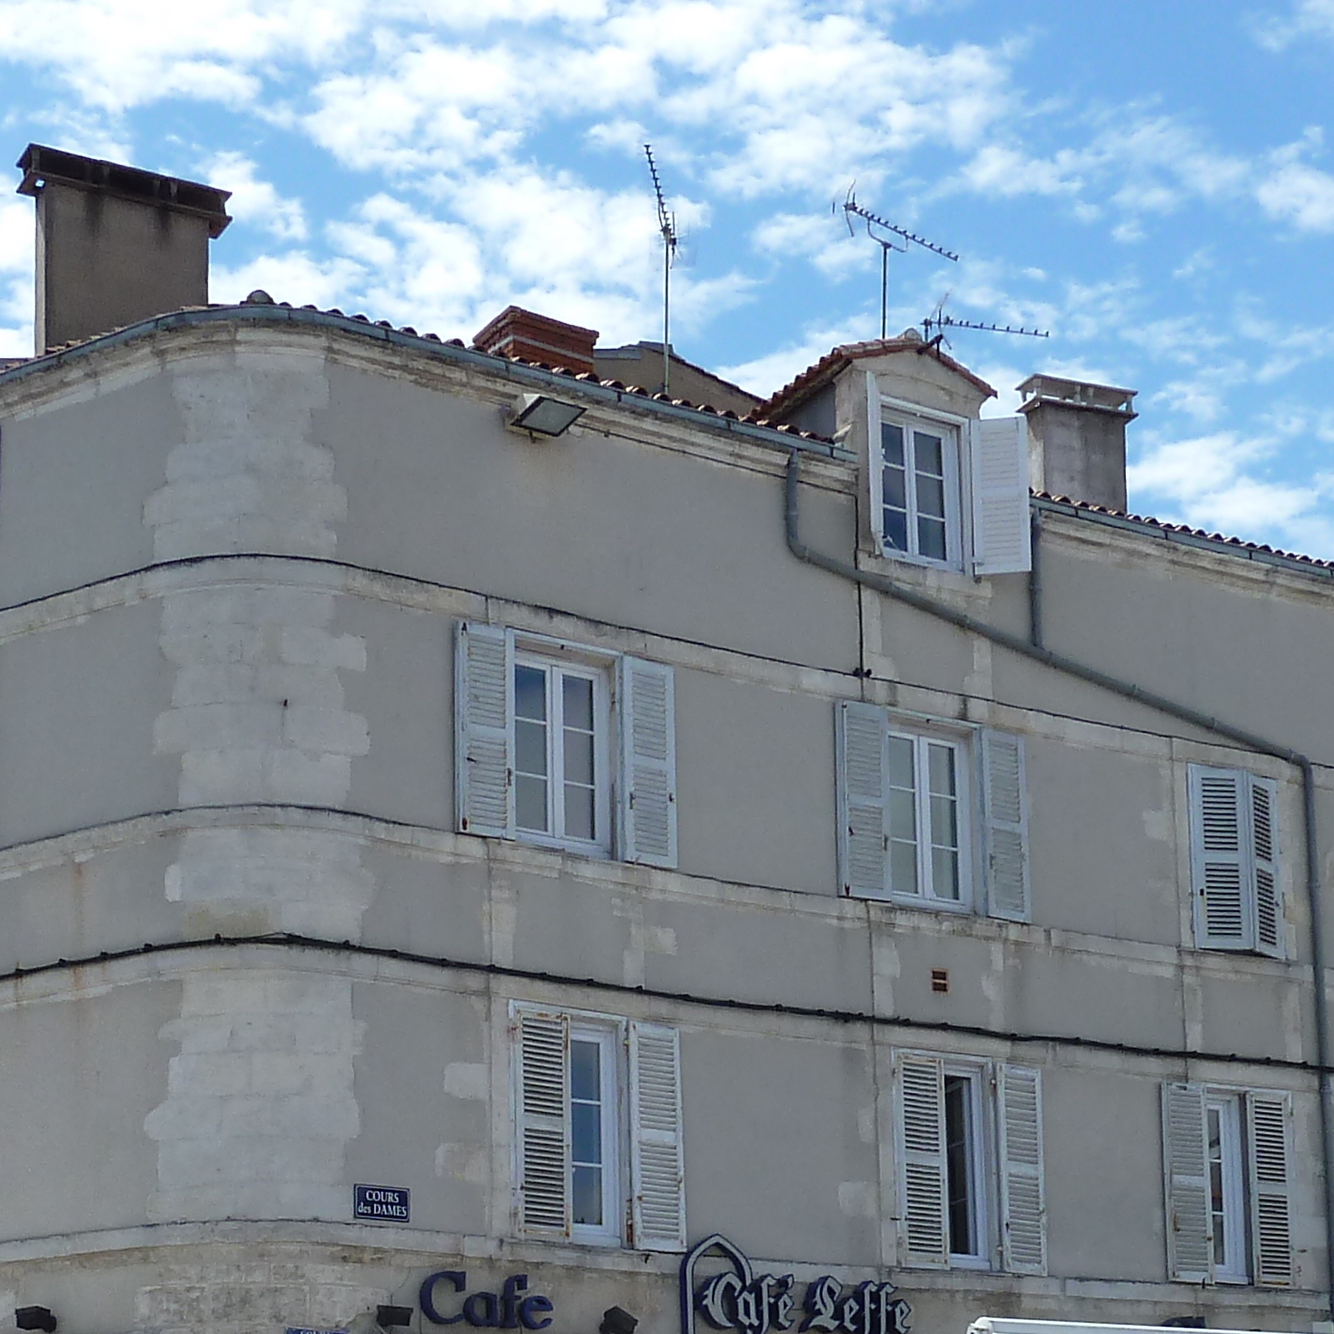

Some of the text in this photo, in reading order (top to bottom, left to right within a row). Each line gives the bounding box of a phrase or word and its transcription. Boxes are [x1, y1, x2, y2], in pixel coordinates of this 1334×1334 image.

[365, 1189, 400, 1204] COURS
[357, 1202, 407, 1217] des DAMES
[419, 1270, 555, 1331] Cafe
